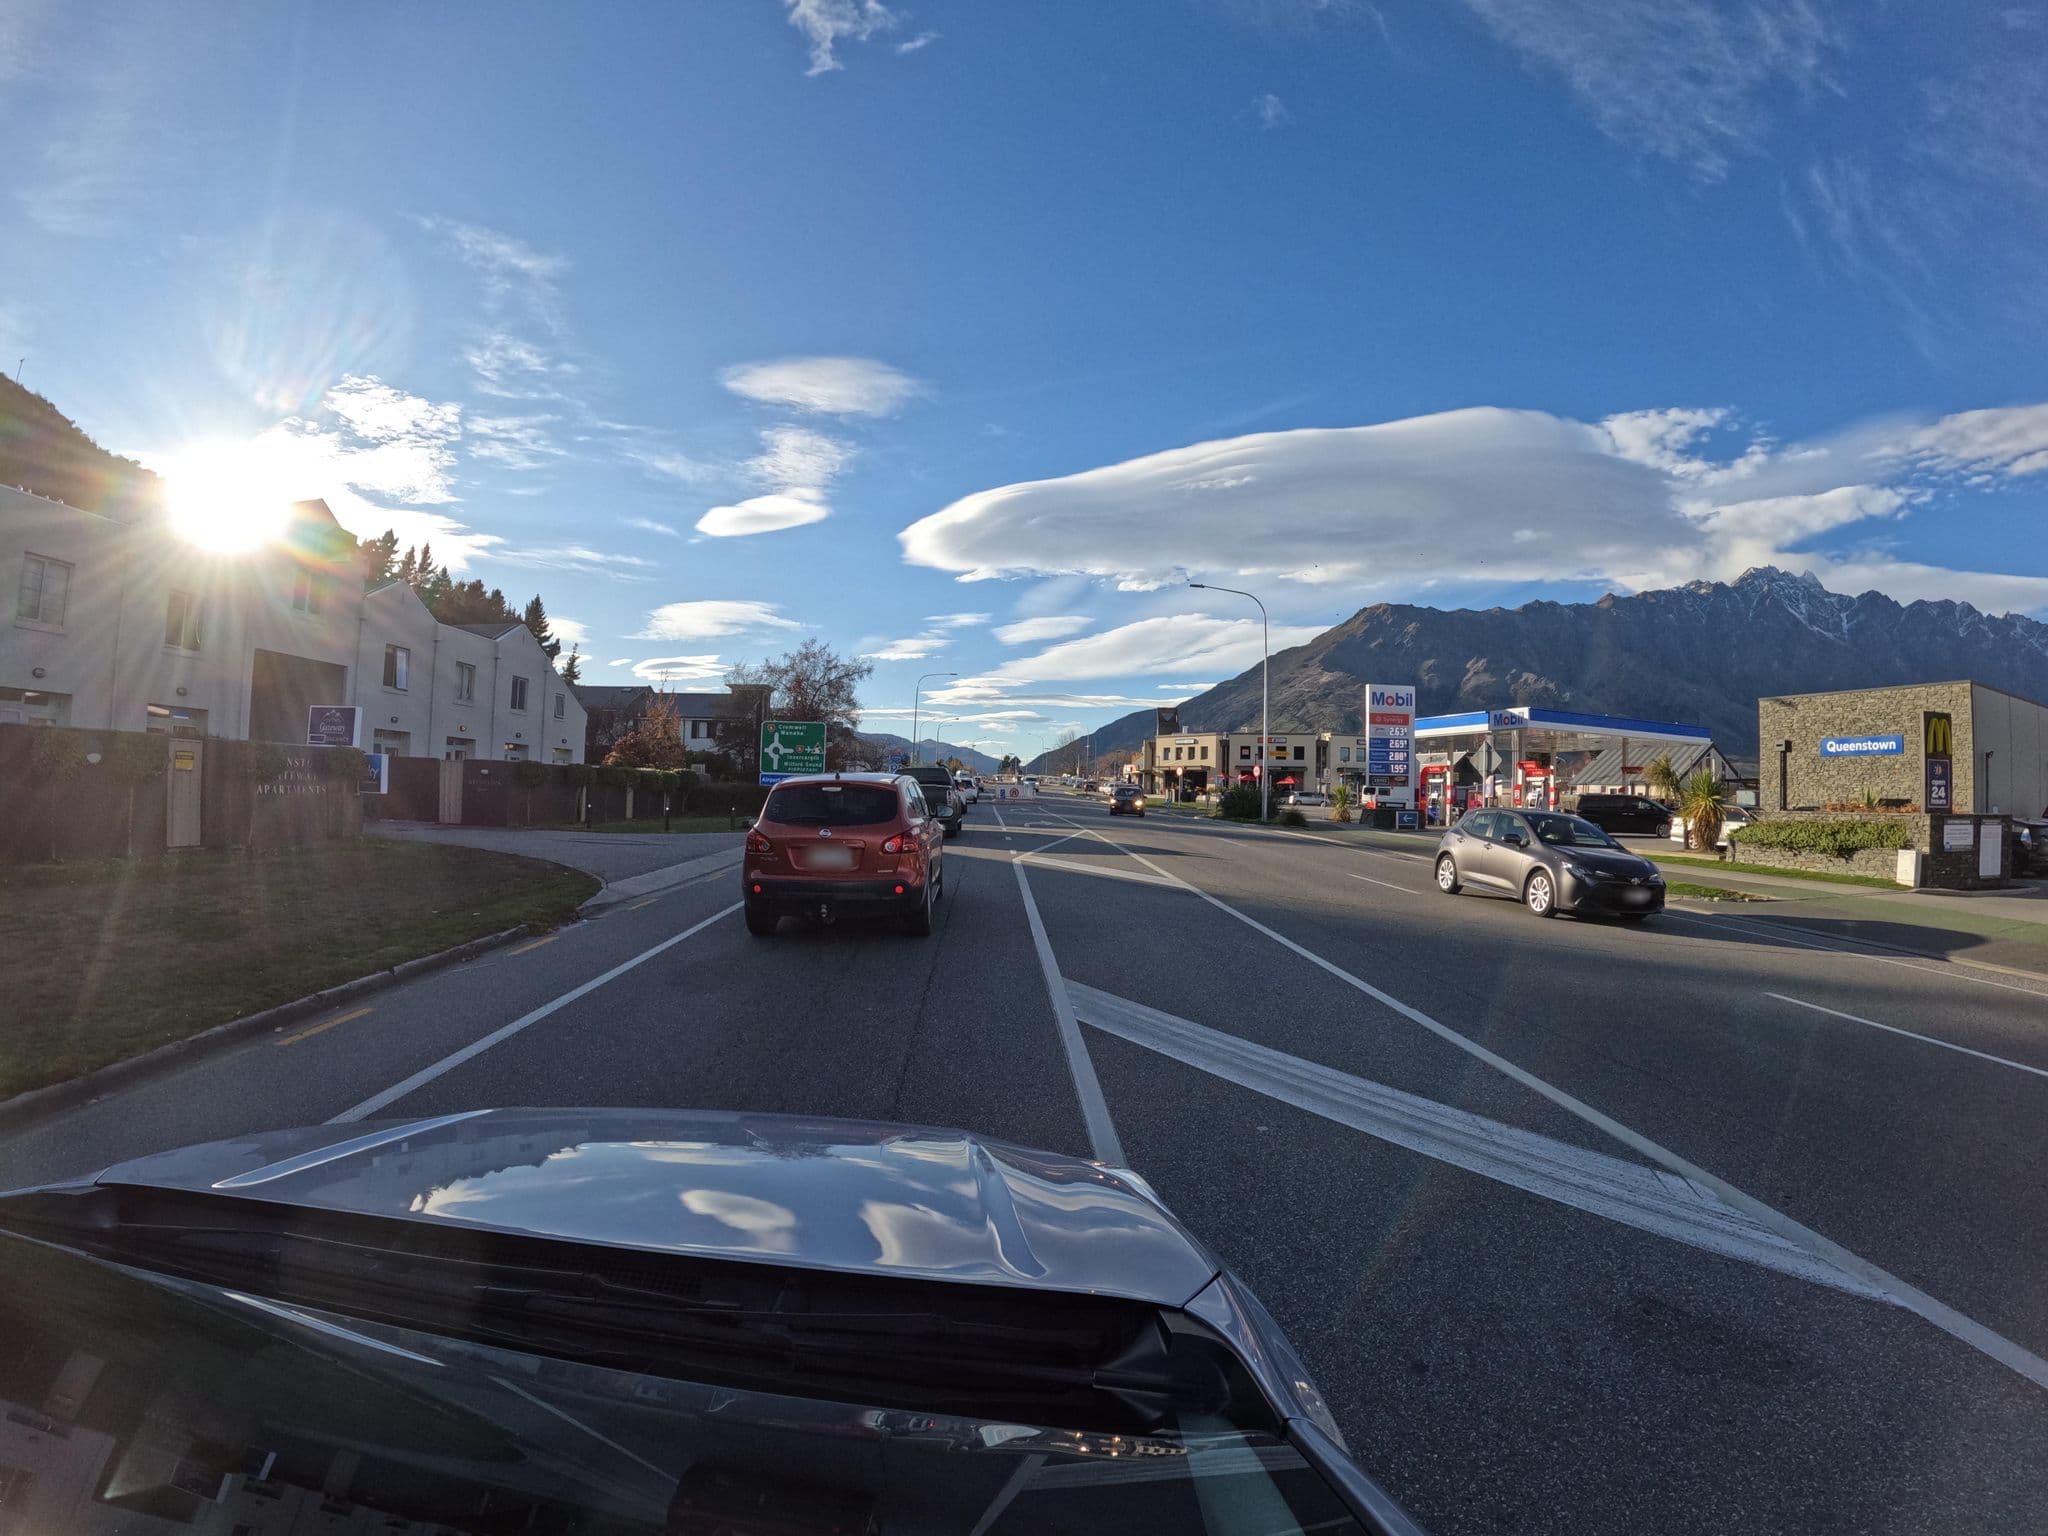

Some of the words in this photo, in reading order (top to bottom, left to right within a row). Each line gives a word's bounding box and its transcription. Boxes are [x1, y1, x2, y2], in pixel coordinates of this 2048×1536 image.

[1372, 692, 1413, 706] Mobil
[1493, 711, 1524, 727] Mobil
[1826, 739, 1897, 754] Queenstown
[256, 784, 328, 795] APARTMENTS
[1931, 786, 1946, 799] 24
